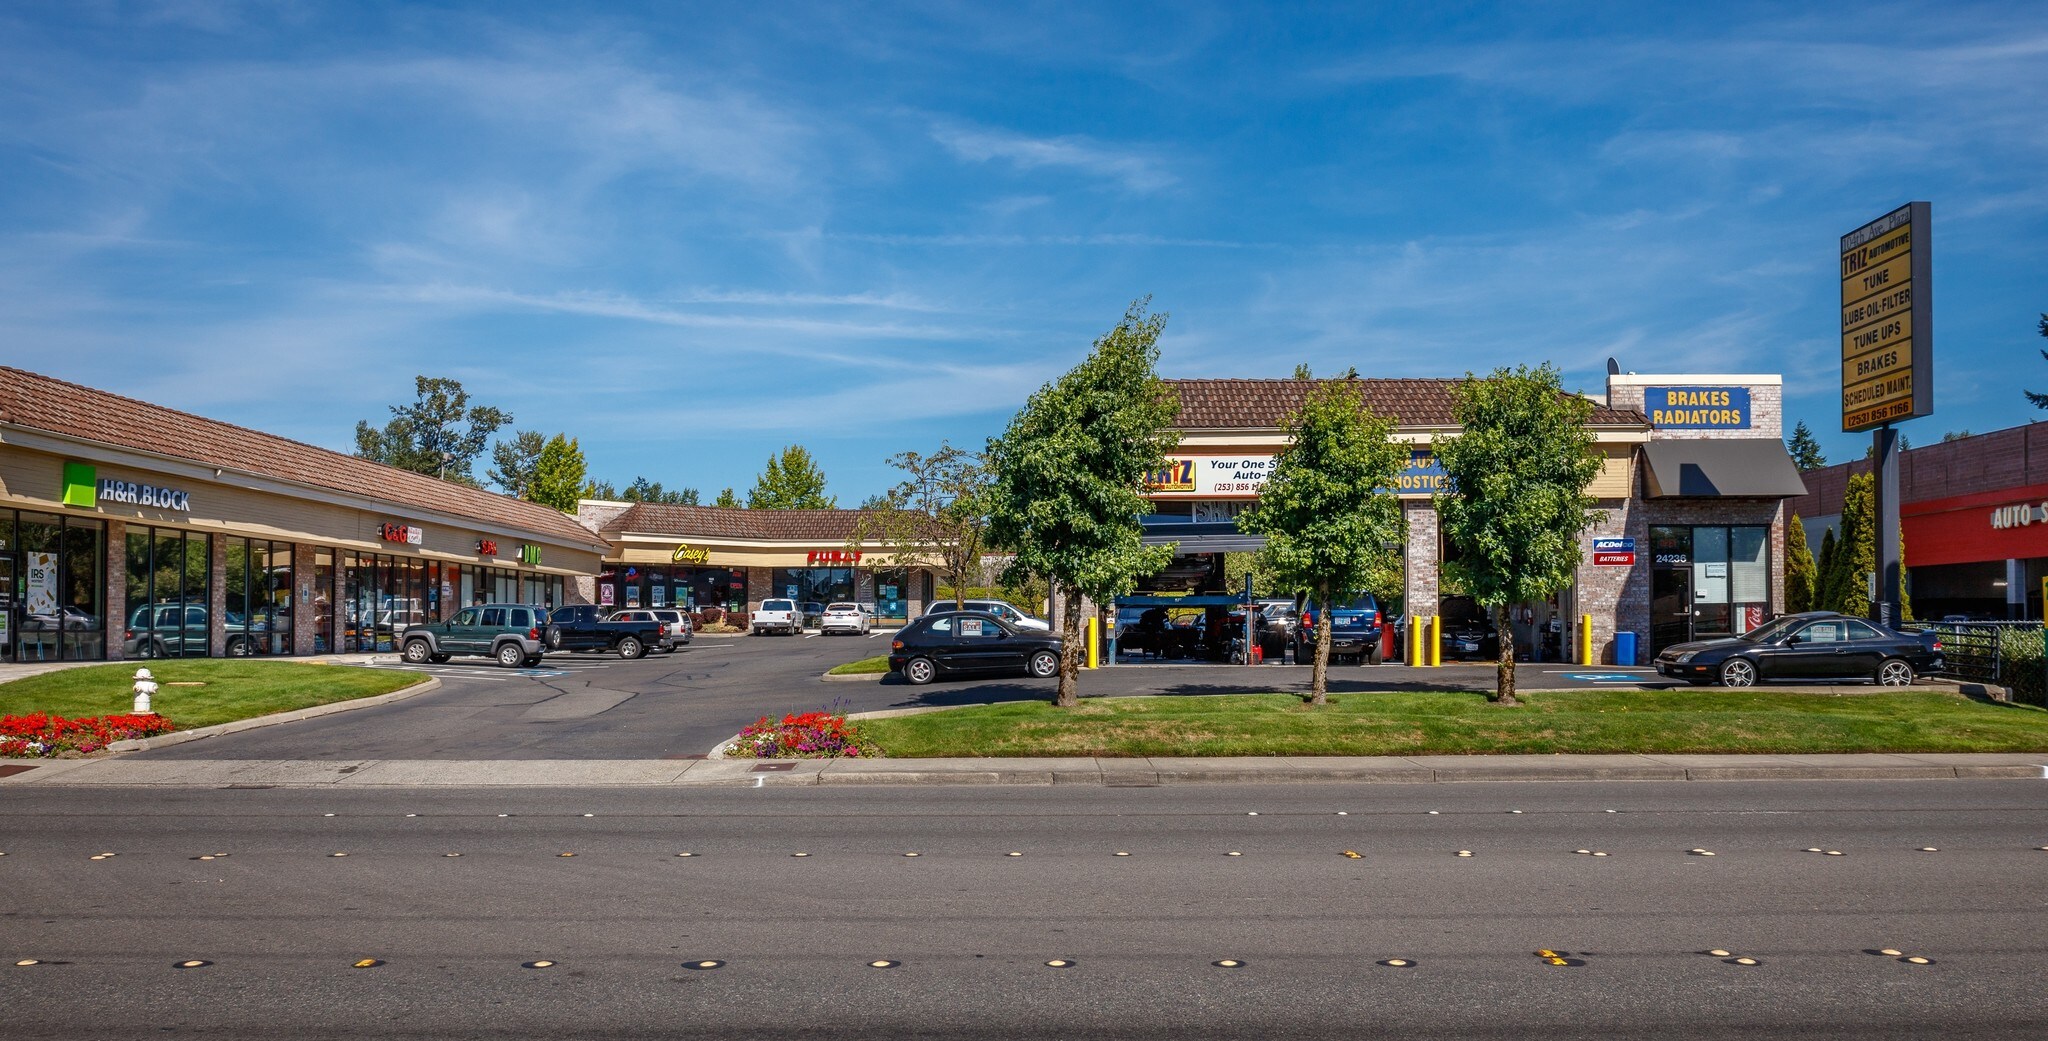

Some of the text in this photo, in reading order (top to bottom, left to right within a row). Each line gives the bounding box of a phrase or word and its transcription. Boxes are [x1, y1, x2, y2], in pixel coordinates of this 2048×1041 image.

[1843, 230, 1865, 251] 104th
[1888, 211, 1910, 229] Plaza
[1842, 232, 1909, 275] TRIZ AUTOMOTIVE
[1863, 269, 1889, 291] TUNE
[1854, 321, 1901, 350] TUNE UPS
[1857, 351, 1897, 376] BRAKES
[1667, 391, 1730, 406] BRAKES
[1844, 375, 1911, 407] SCHEDULED MAINT.
[1653, 409, 1741, 425] RADIATORS
[1848, 401, 1909, 427] (253) 856 1166
[1210, 460, 1238, 469] Your
[1241, 460, 1265, 469] One
[1233, 471, 1276, 480] Auto-R
[101, 479, 191, 512] H&R BLOCK
[1214, 483, 1235, 493] (253)
[1236, 483, 1249, 491] 856
[1993, 503, 2031, 529] AUTO
[384, 522, 408, 543] C&G
[673, 544, 711, 563] Casey's
[1656, 554, 1687, 563] 24236
[31, 568, 44, 579] IRS
